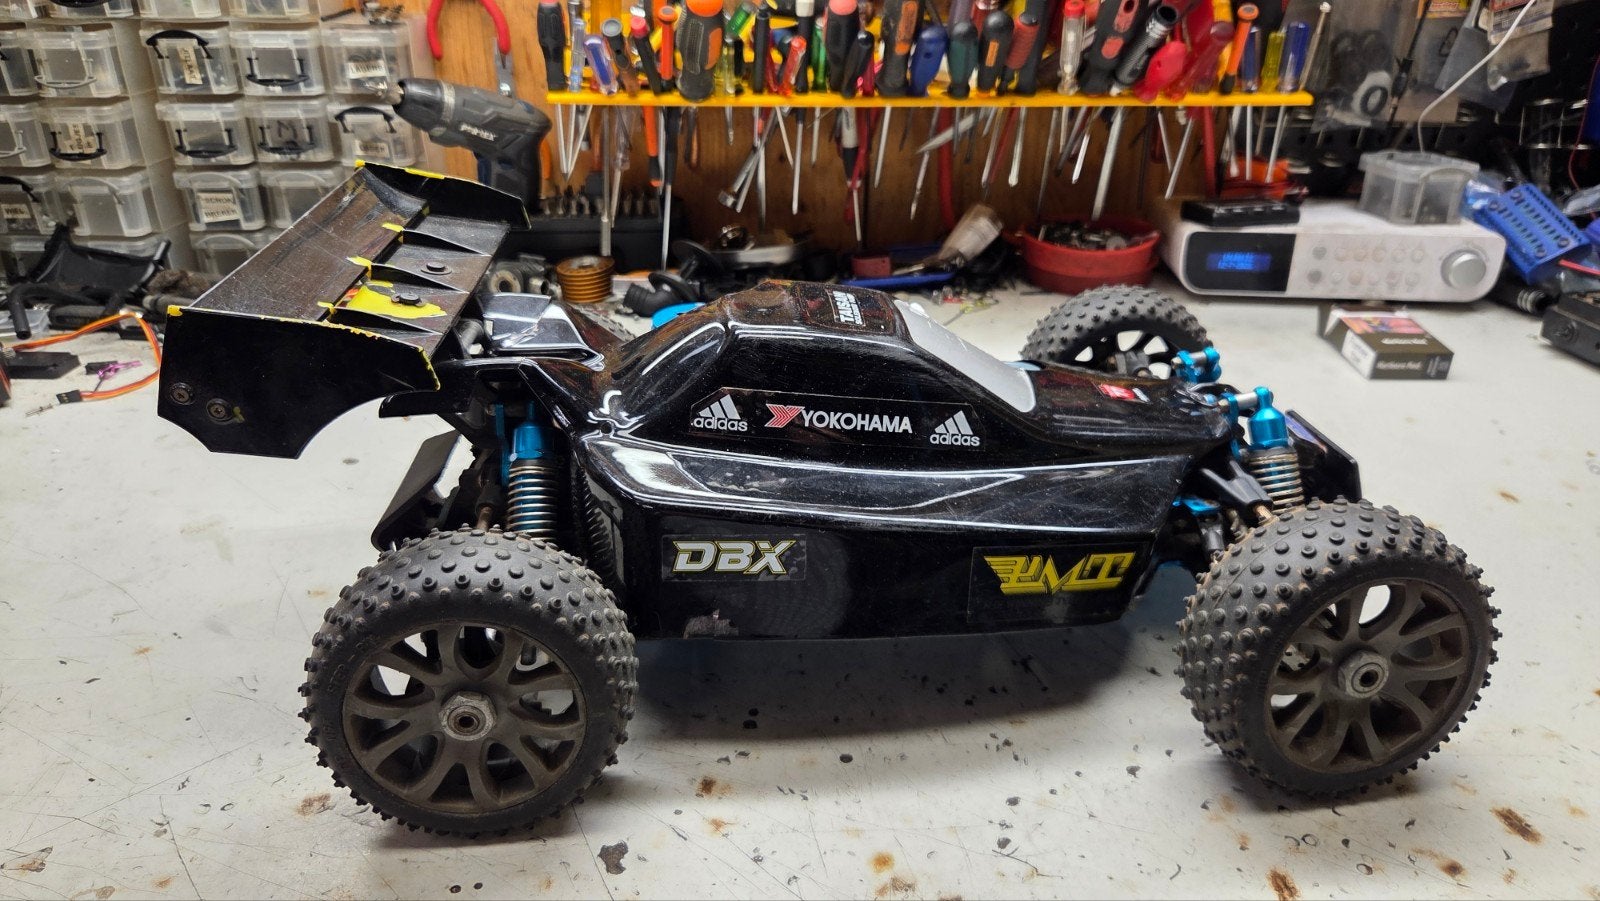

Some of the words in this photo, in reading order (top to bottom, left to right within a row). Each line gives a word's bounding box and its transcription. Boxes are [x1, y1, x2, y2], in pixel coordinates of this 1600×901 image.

[832, 290, 854, 322] TAISAN
[692, 416, 748, 432] adidas
[801, 409, 913, 434] YOKOHAMA
[929, 431, 981, 447] adidas
[672, 540, 797, 575] DBX
